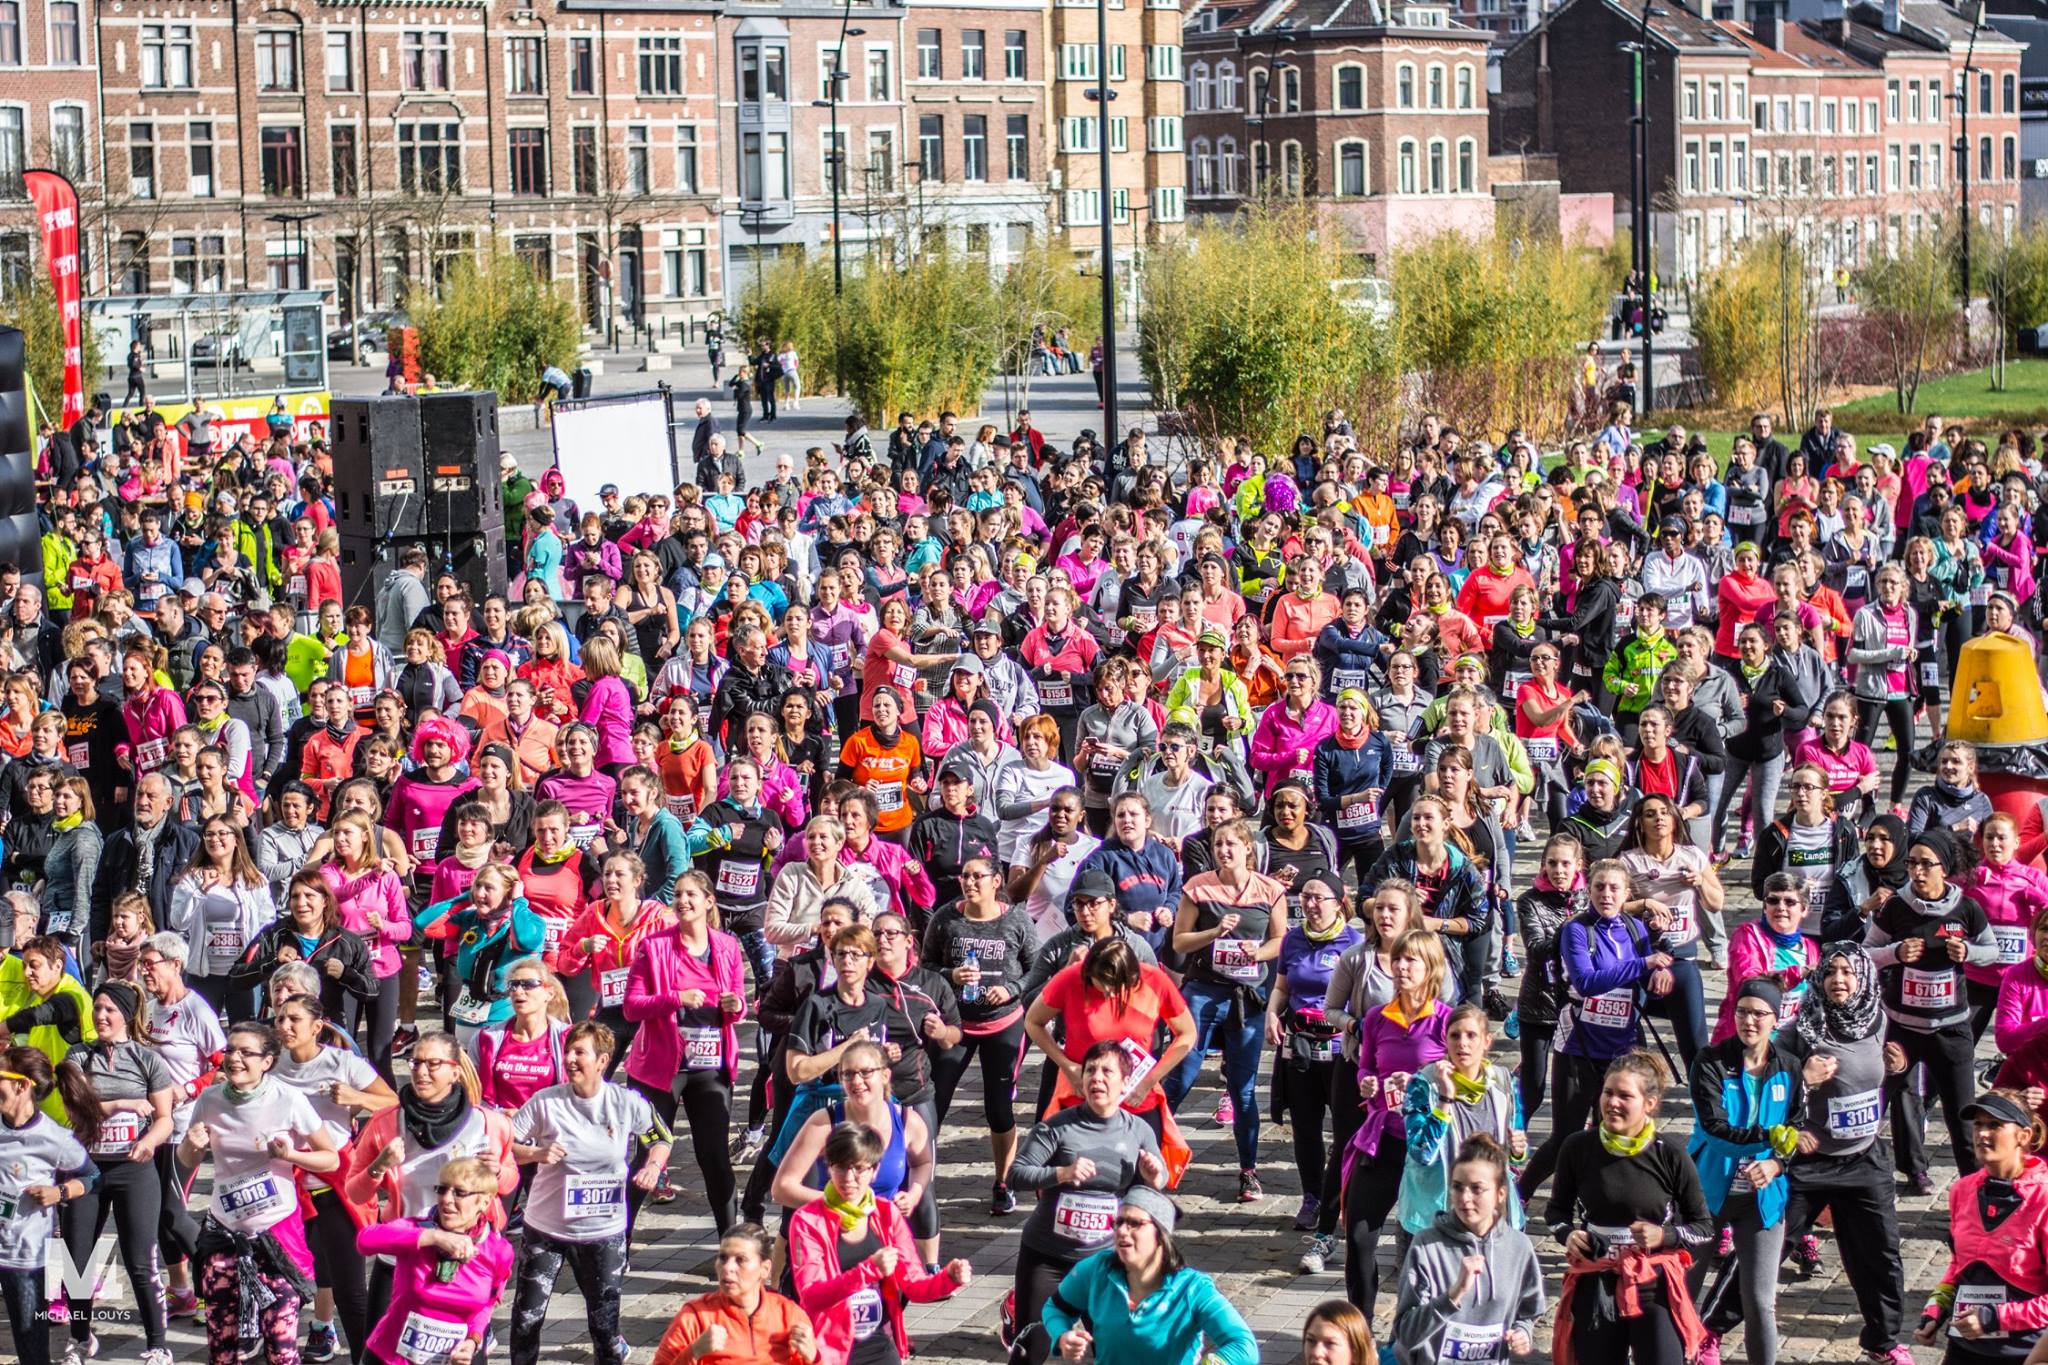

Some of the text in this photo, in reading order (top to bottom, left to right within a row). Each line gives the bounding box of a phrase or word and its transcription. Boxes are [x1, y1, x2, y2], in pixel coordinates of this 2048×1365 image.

[1346, 804, 1371, 819] 6506
[728, 873, 754, 886] 6523
[214, 933, 240, 946] 6386
[1915, 982, 1946, 997] 6704
[1596, 999, 1627, 1016] 6593
[688, 1040, 720, 1057] 6623
[514, 1061, 529, 1072] the
[530, 1064, 551, 1076] way
[1772, 1084, 1786, 1102] 10
[1846, 1110, 1877, 1127] 3174
[235, 1183, 267, 1208] 3018
[583, 1188, 615, 1205] 3017
[1070, 1212, 1109, 1229] 6553
